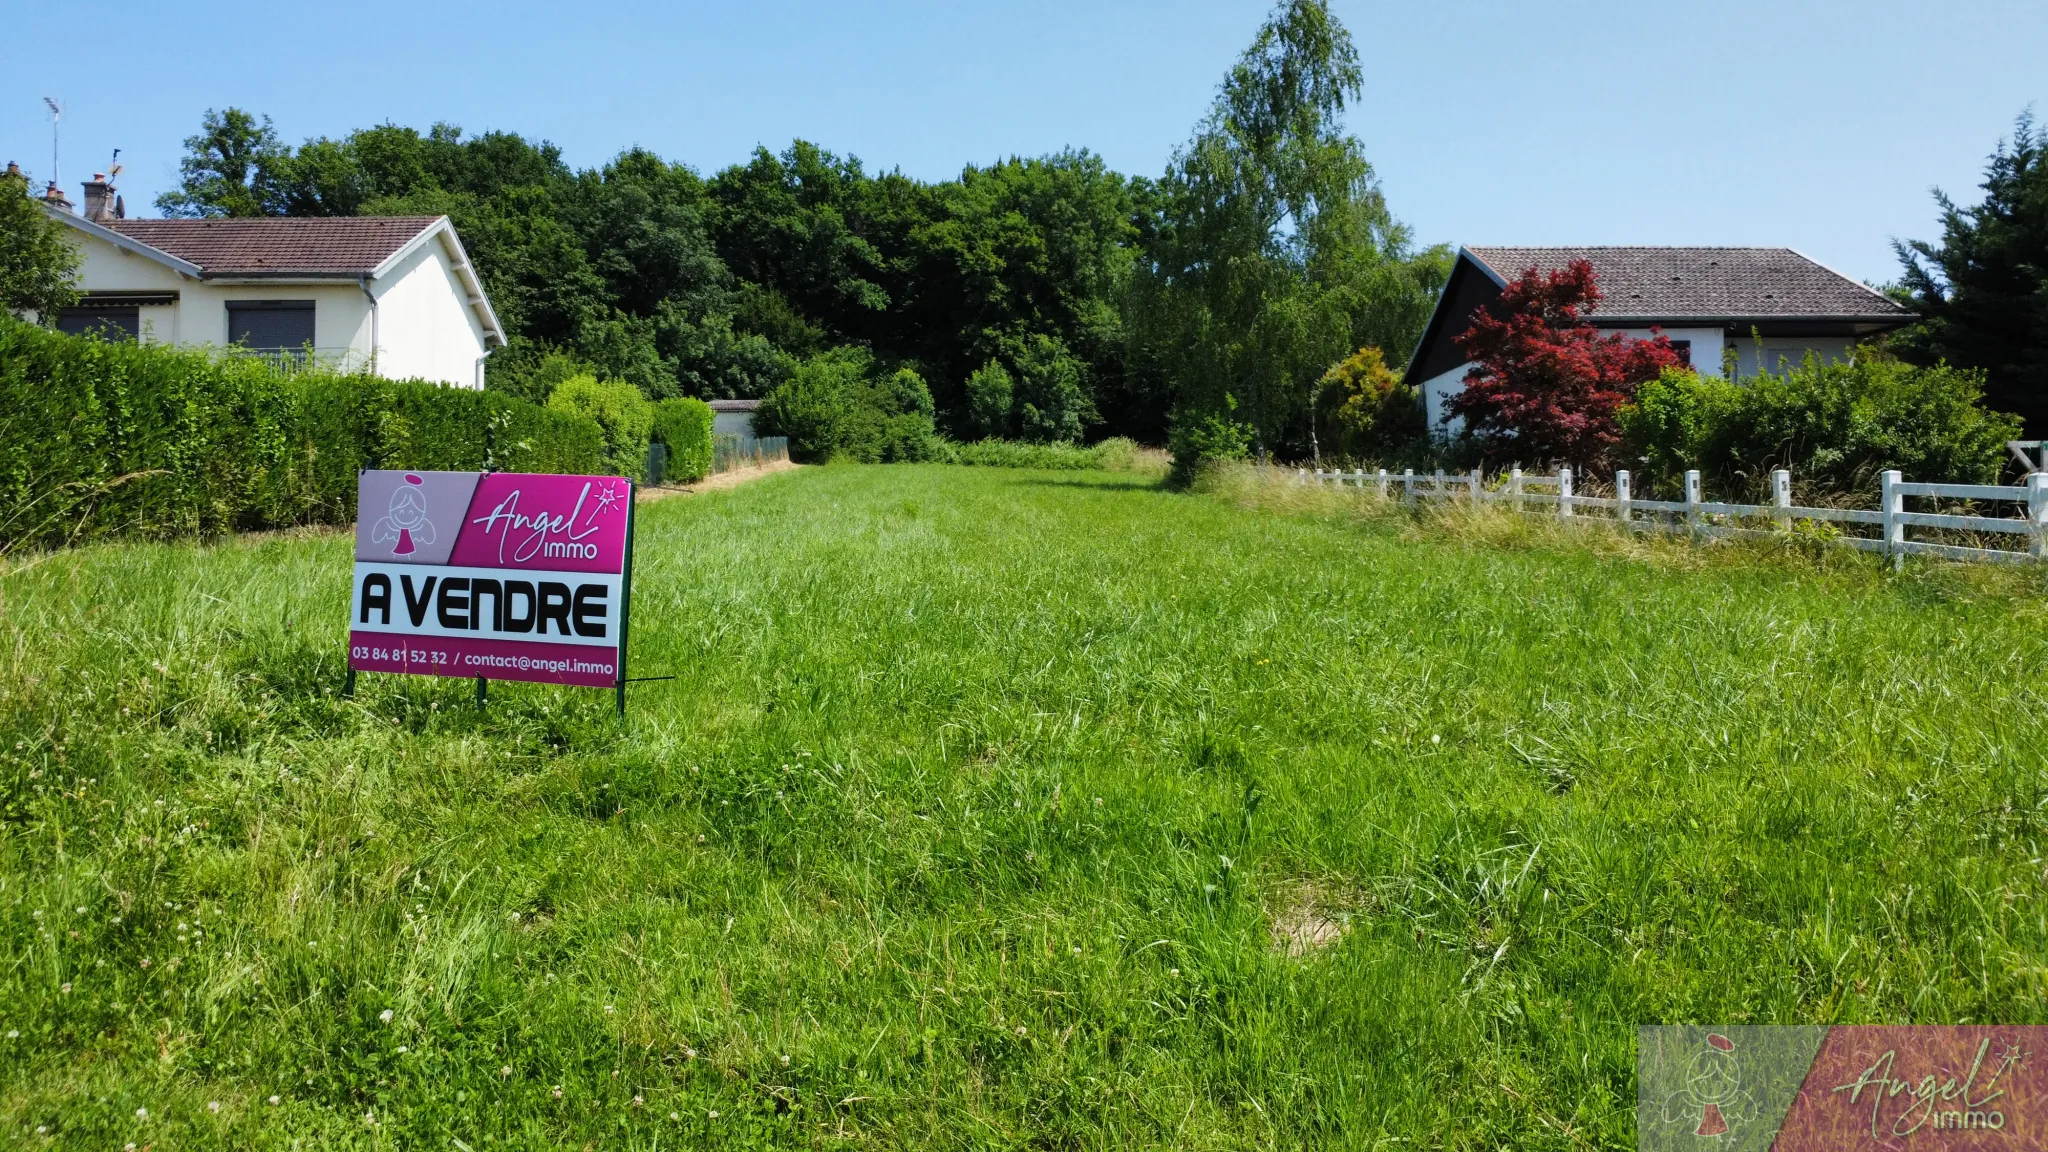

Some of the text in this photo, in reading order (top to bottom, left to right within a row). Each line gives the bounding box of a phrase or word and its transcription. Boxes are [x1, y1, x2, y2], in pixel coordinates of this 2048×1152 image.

[473, 482, 598, 564] Angel
[360, 573, 608, 638] A VENDRE
[352, 646, 614, 675] 03 84 81 52 32 / contact@angel.immo
